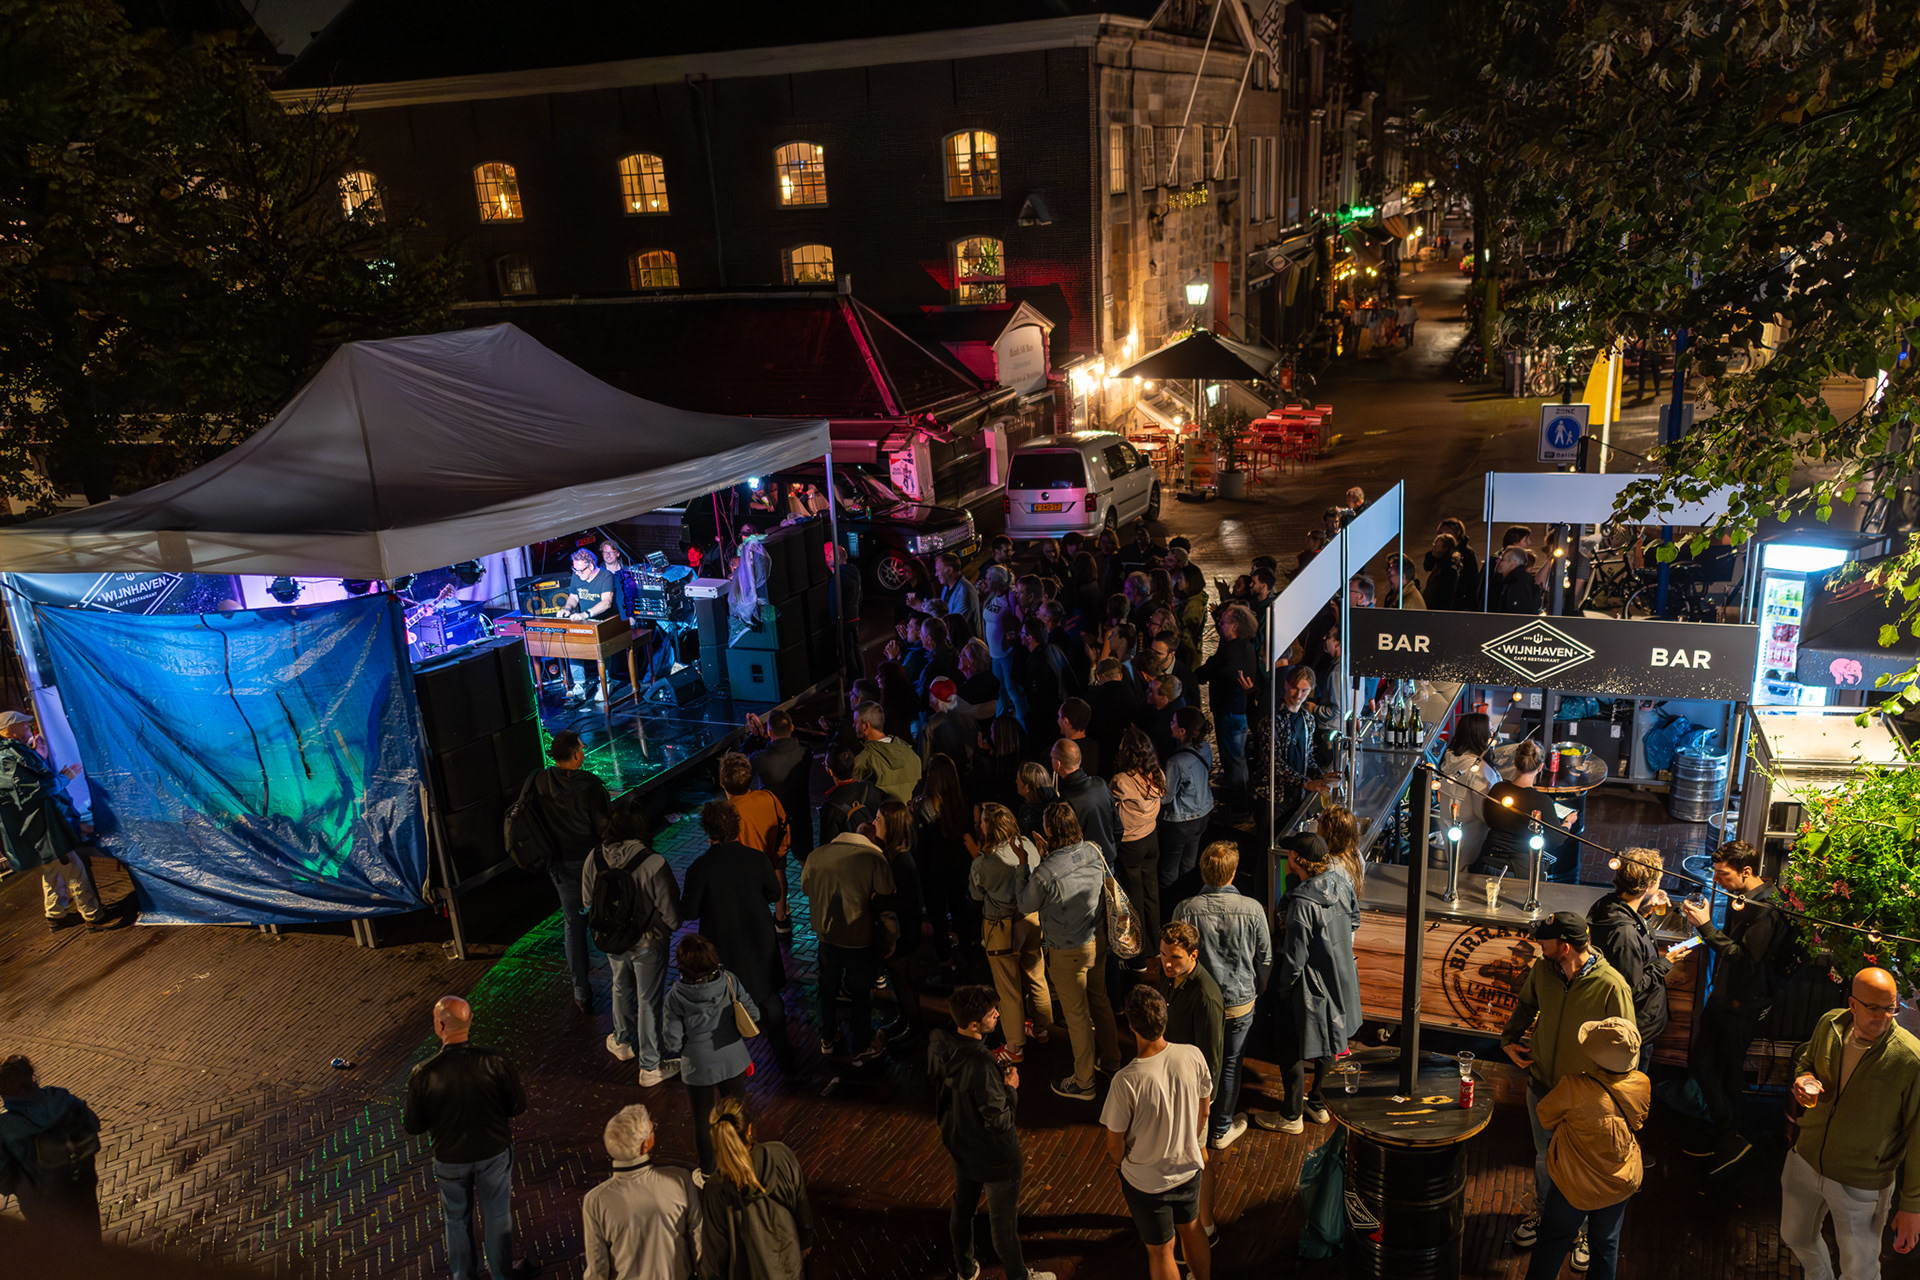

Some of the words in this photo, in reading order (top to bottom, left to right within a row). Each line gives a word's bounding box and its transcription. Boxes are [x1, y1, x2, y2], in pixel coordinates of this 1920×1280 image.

[101, 576, 167, 602] WIJNHAVEN
[129, 592, 157, 604] RESTAURANT
[1378, 633, 1430, 653] BAR
[1503, 644, 1573, 657] WIJNHAVEN
[1651, 648, 1711, 669] BAR
[1449, 926, 1512, 972] BIRRA
[1467, 982, 1519, 1008] L'AUTEN
